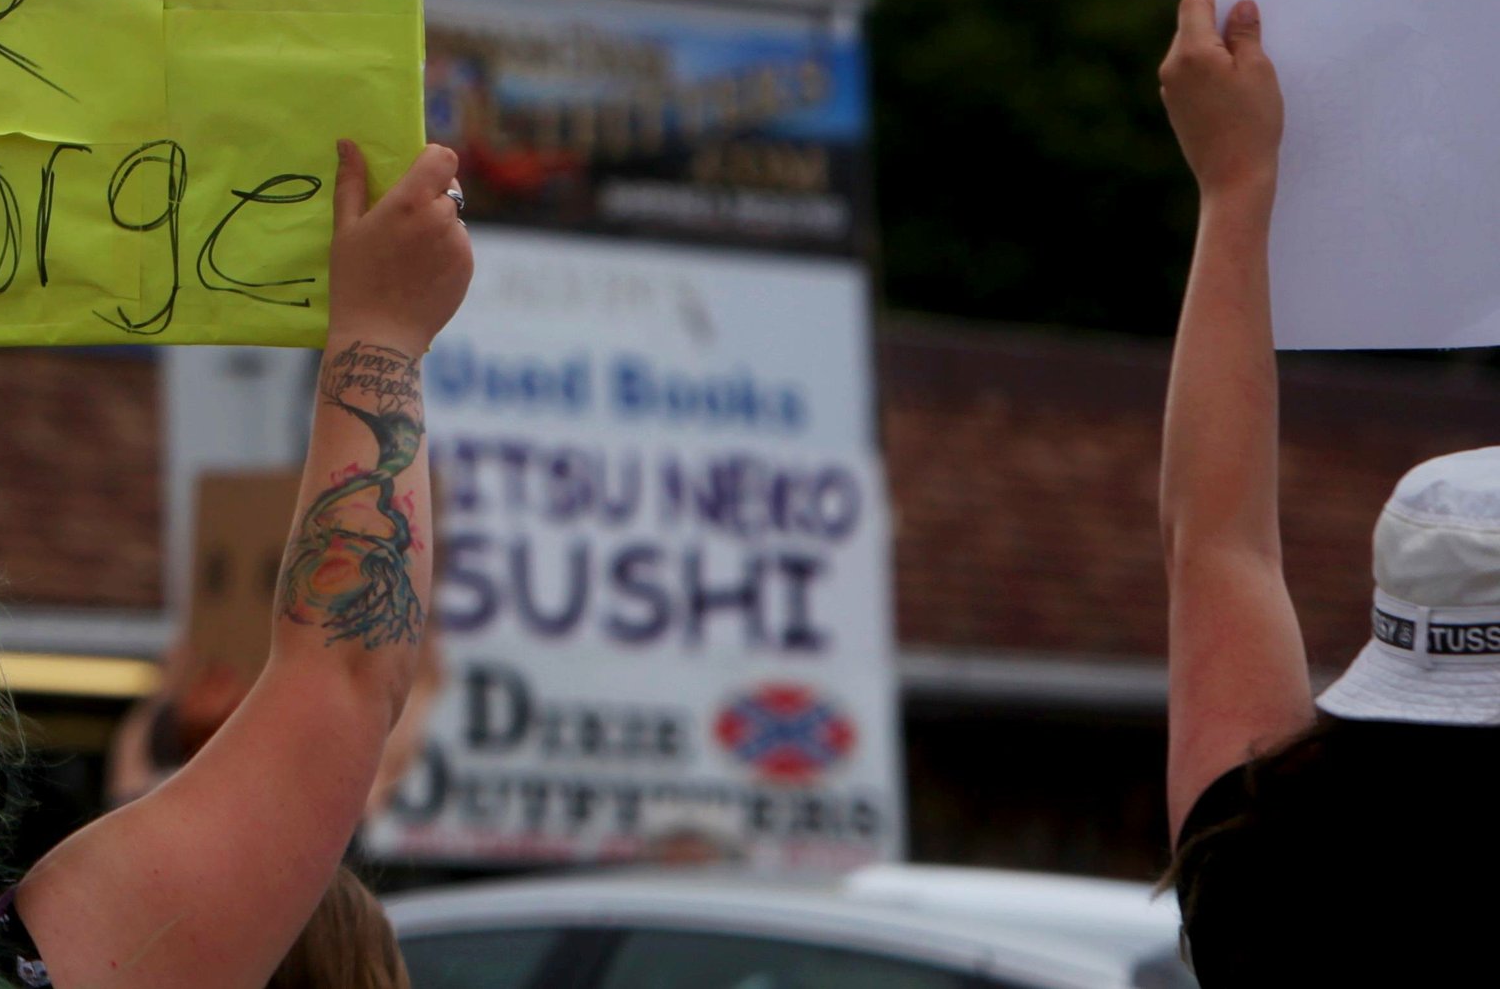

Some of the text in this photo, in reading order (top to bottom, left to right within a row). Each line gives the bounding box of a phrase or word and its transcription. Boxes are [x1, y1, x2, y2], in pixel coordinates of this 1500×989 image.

[424, 340, 592, 412] Used
[609, 353, 808, 434] Books
[428, 436, 642, 525] ITSU
[436, 530, 834, 651] SUSHI
